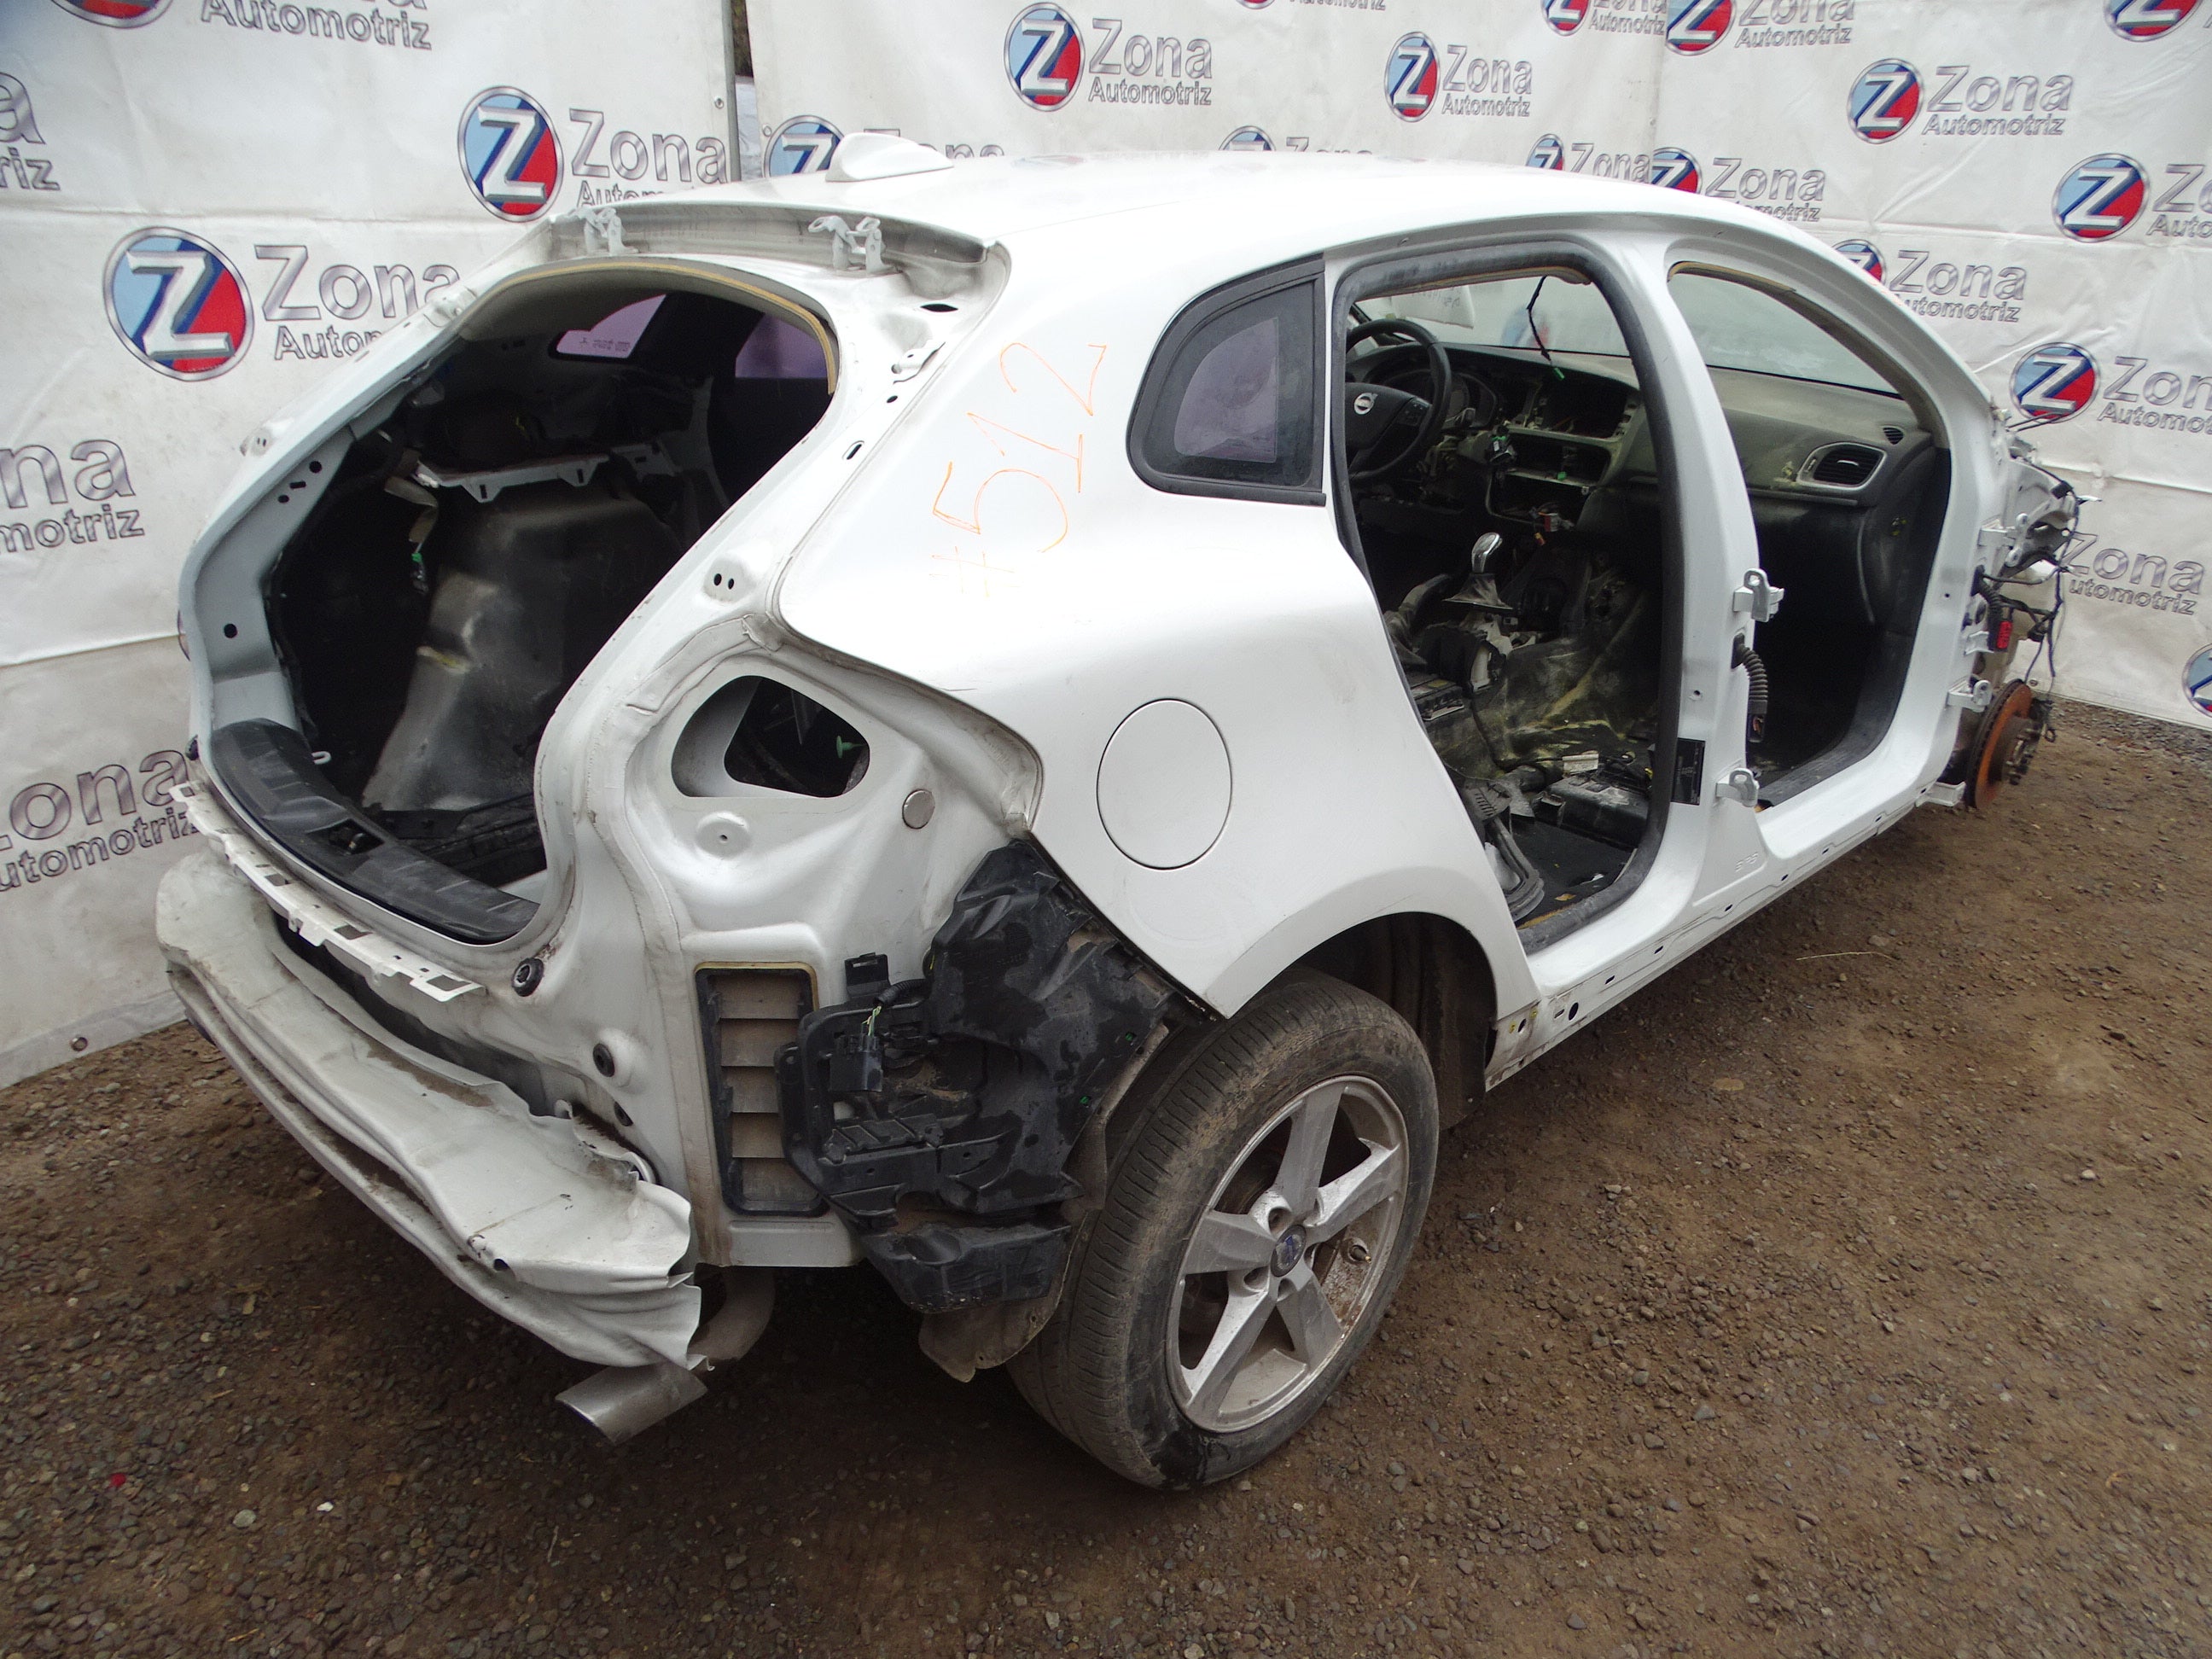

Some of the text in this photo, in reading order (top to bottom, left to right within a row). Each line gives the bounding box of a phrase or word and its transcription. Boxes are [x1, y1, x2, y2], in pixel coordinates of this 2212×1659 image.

[201, 0, 432, 50] Automotriz
[1588, 9, 1665, 36] Automotriz
[1734, 23, 1853, 48] Automotriz
[1089, 17, 1213, 79] Zona
[1442, 44, 1533, 95] Zona
[1087, 76, 1212, 105] Automotriz
[1441, 92, 1530, 117] Automotriz
[1926, 65, 2075, 113] Zona
[568, 108, 729, 185] Zona
[1921, 113, 2066, 136] Automotriz
[1704, 157, 1826, 201] Zona
[1889, 249, 2028, 300] Zona
[2059, 531, 2206, 596] Zona
[0, 749, 190, 852] ona
